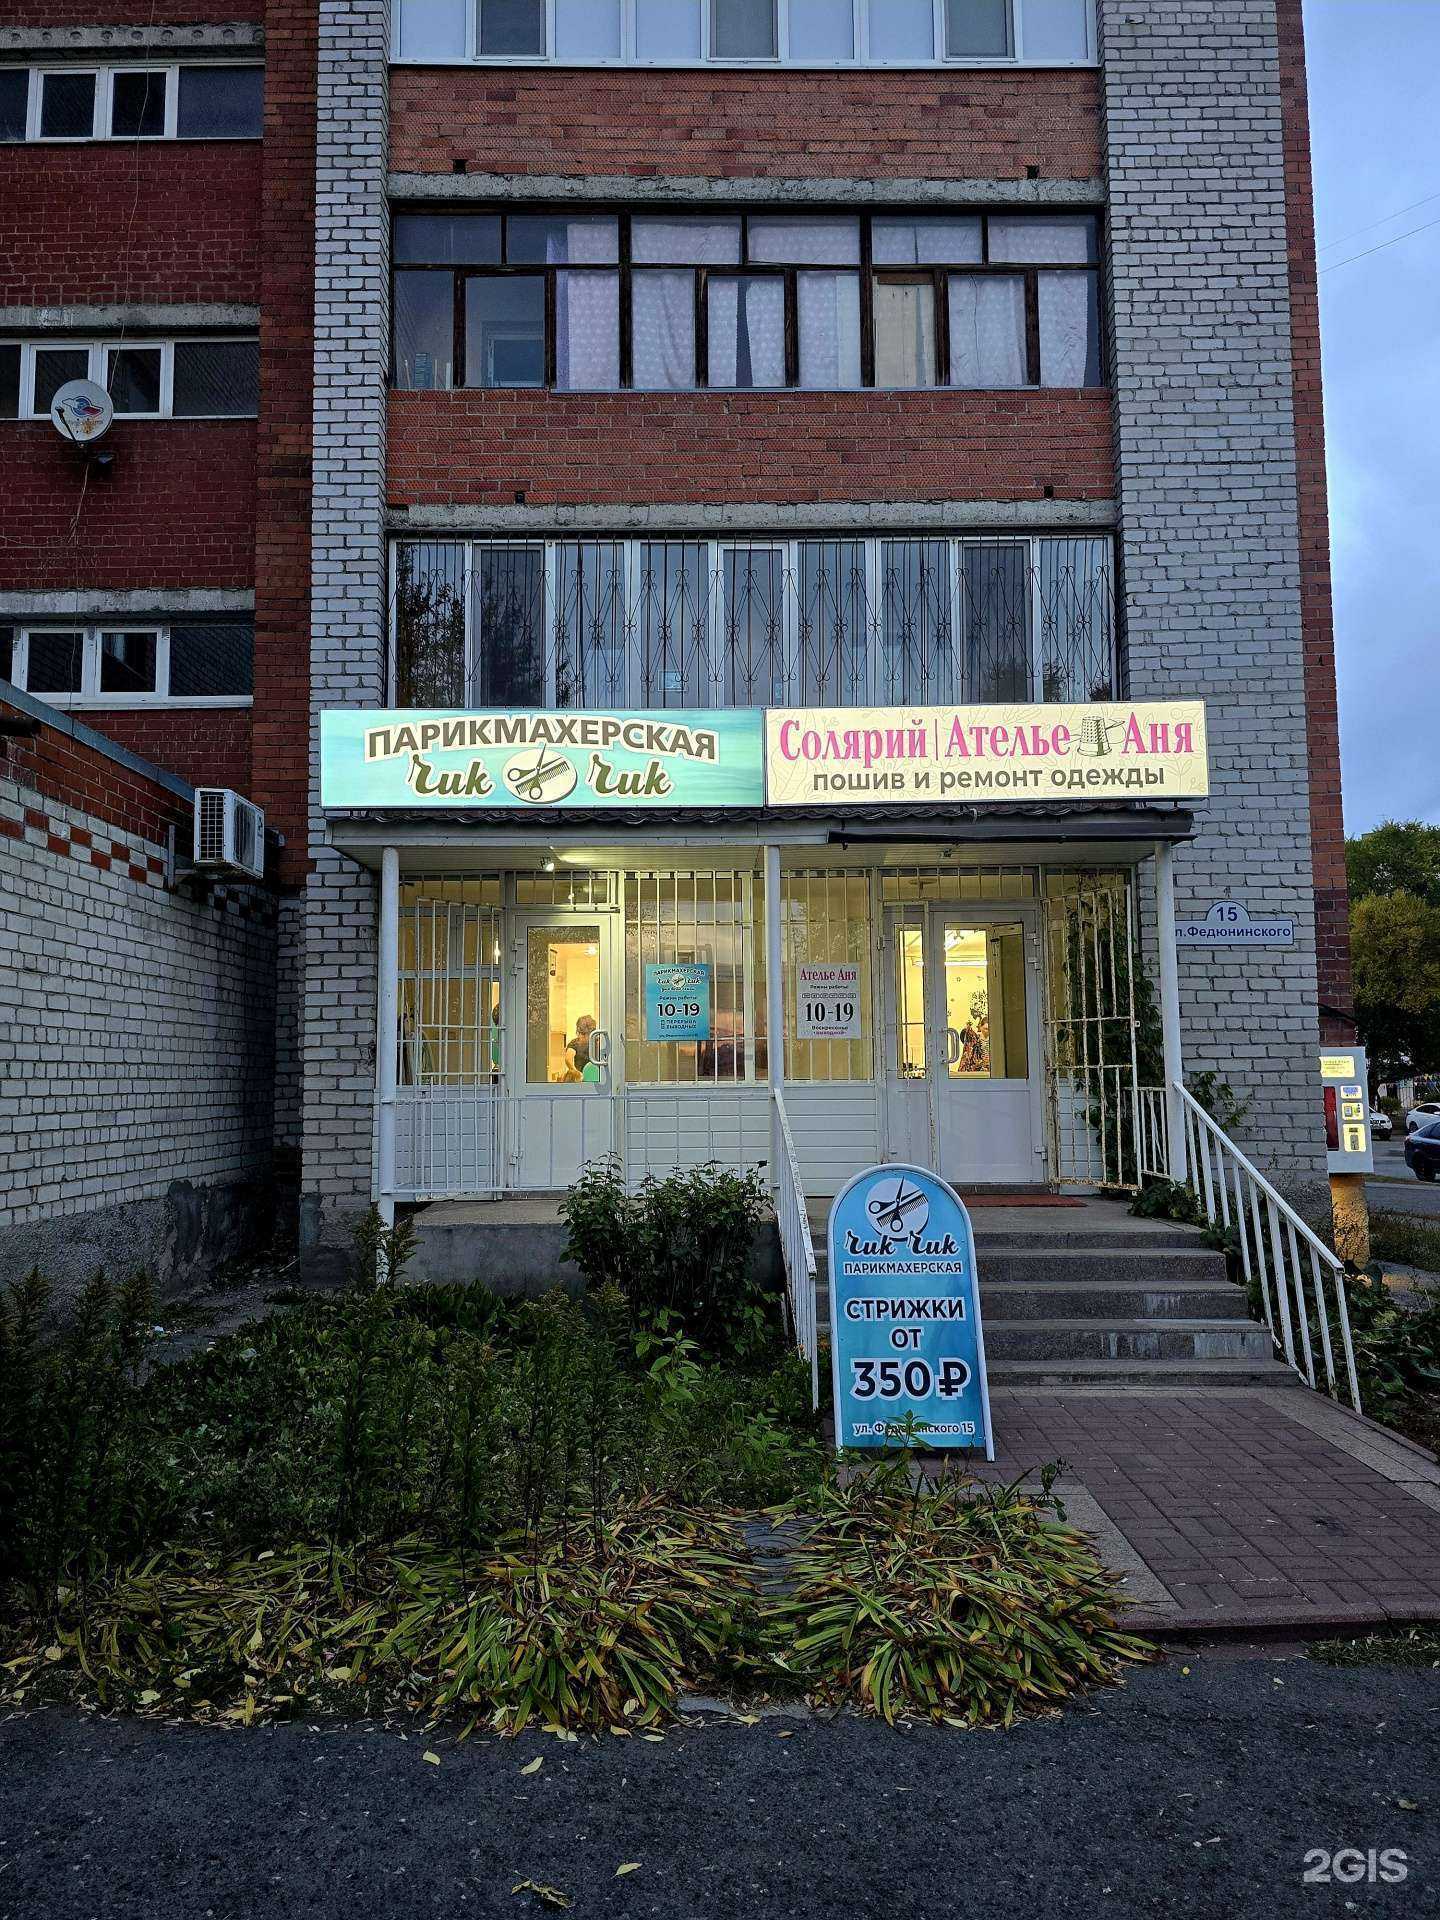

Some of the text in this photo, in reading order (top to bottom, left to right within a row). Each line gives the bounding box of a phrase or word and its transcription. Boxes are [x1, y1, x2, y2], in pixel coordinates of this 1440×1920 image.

[368, 718, 716, 760] ПАРИКМАХЕРСКАЯ
[779, 711, 1194, 768] Солярий Ателье Аня
[407, 753, 672, 795] Чик Чик
[813, 767, 1165, 794] пошив и ремонт одежды
[1216, 906, 1238, 921] 15
[800, 968, 857, 981] Ателье Аня
[657, 1002, 700, 1017] 10-19
[845, 1230, 959, 1255] Чик Чик
[844, 1262, 962, 1274] ПАРИКМАХЕРСКАЯ
[846, 1299, 964, 1319] СТРИЖКИ
[891, 1328, 922, 1348] ОТ
[854, 1423, 872, 1434] ул.
[961, 1422, 974, 1433] 15
